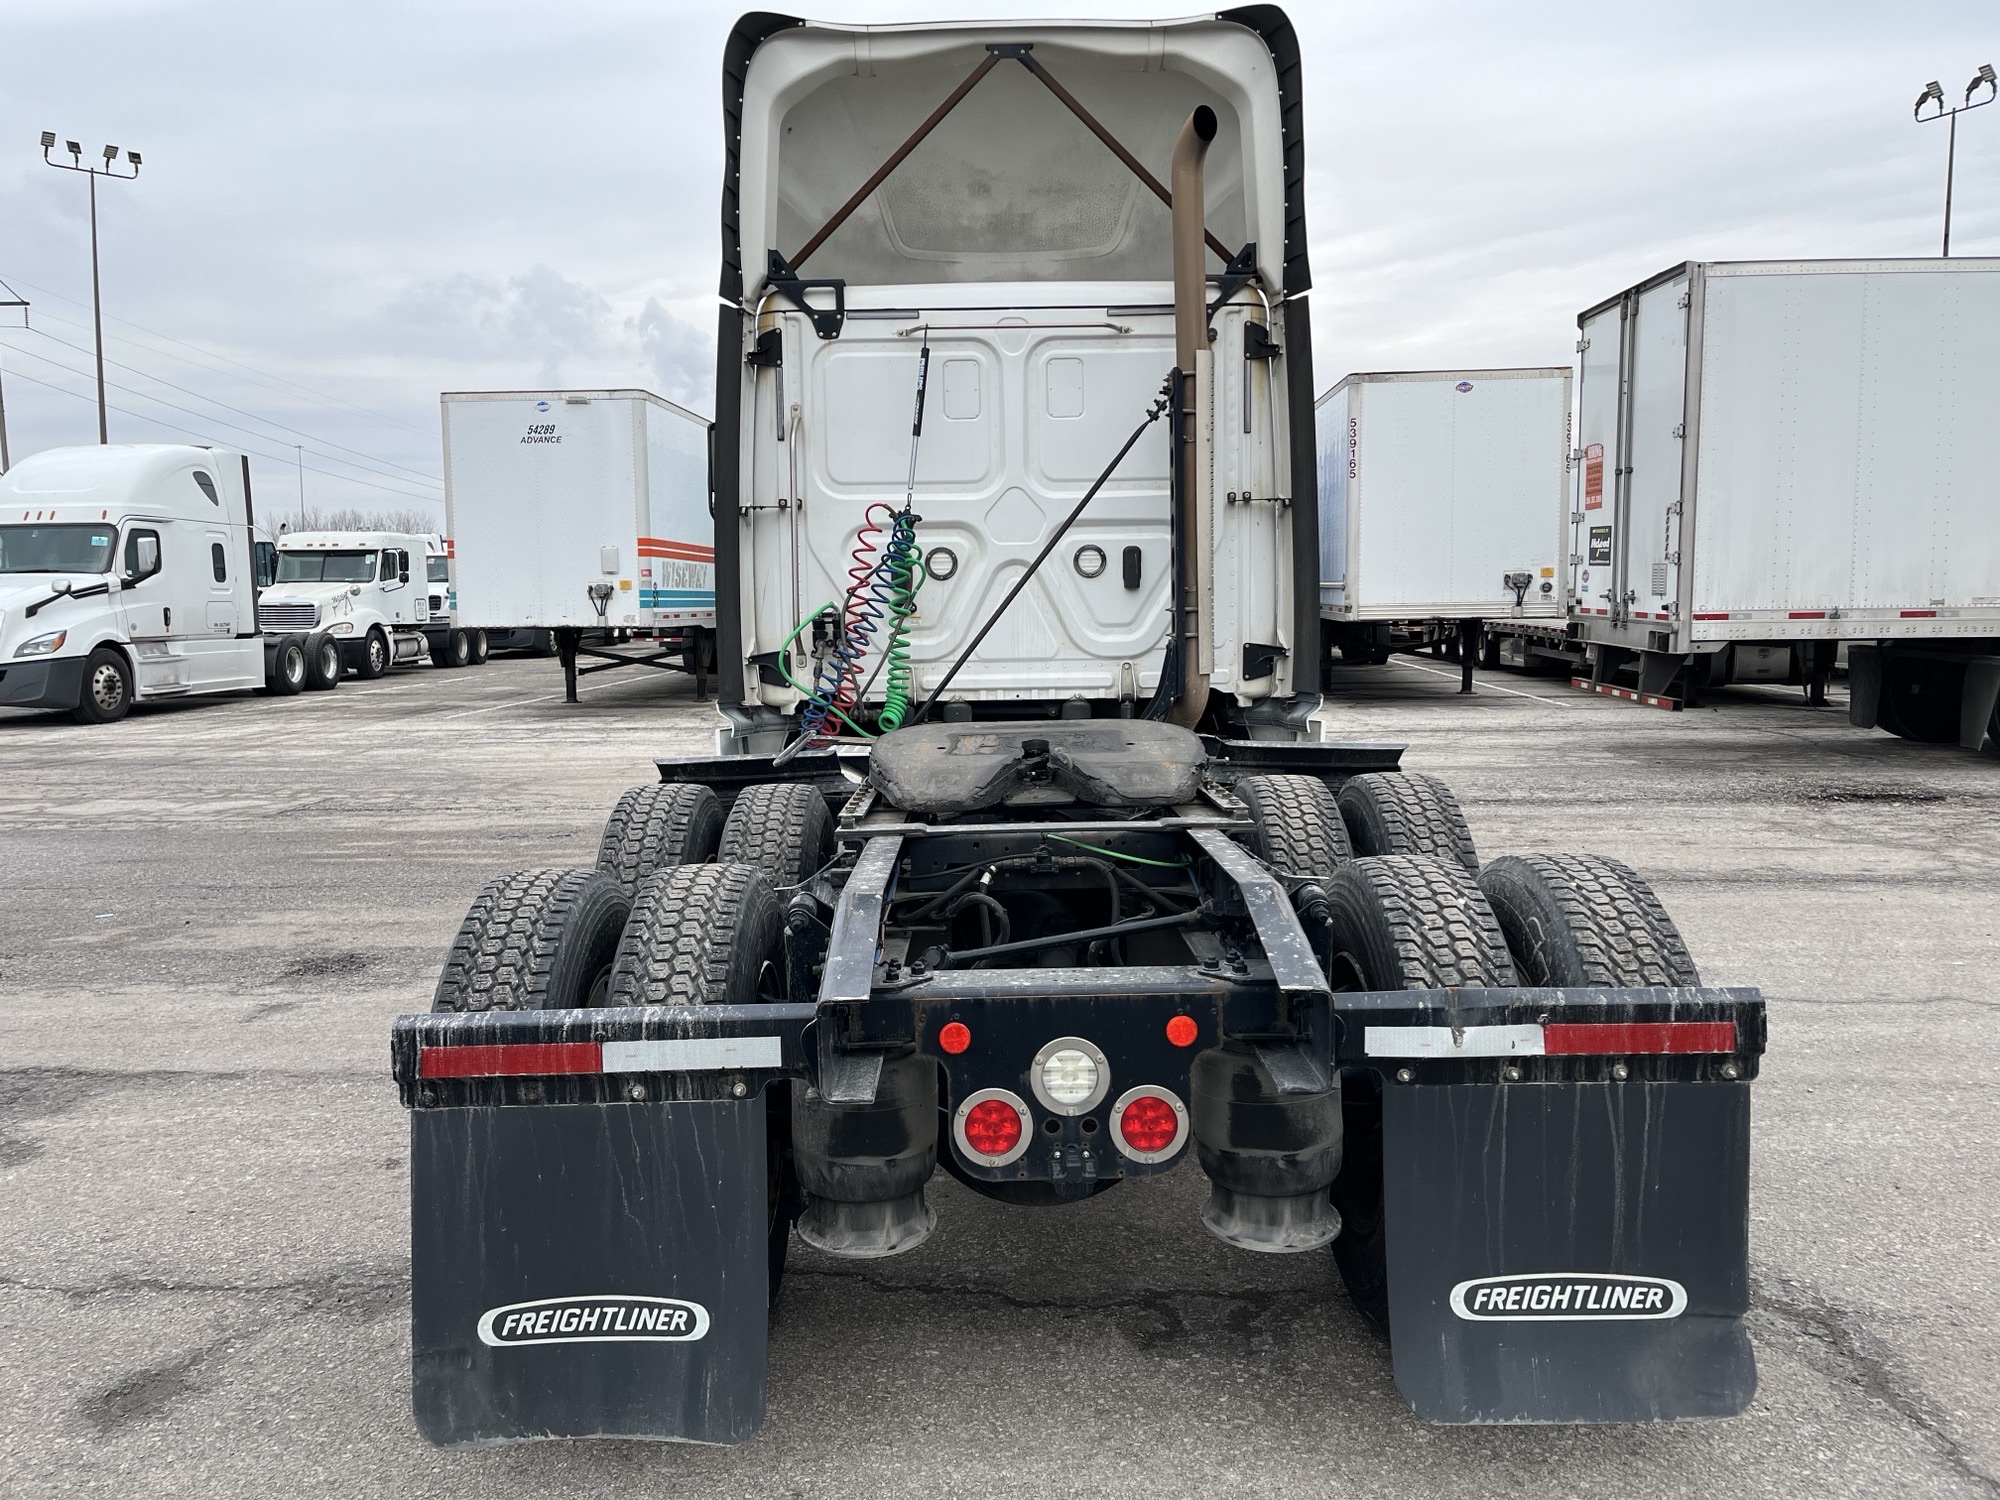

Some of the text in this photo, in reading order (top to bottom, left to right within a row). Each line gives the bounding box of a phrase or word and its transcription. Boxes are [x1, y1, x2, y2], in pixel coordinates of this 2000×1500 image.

[520, 436, 562, 444] ADVANCE
[527, 424, 556, 435] 54289
[1349, 418, 1357, 479] 539165
[1473, 1285, 1664, 1310] FREIGHTLINER
[501, 1307, 688, 1337] FREIGHTLINER
